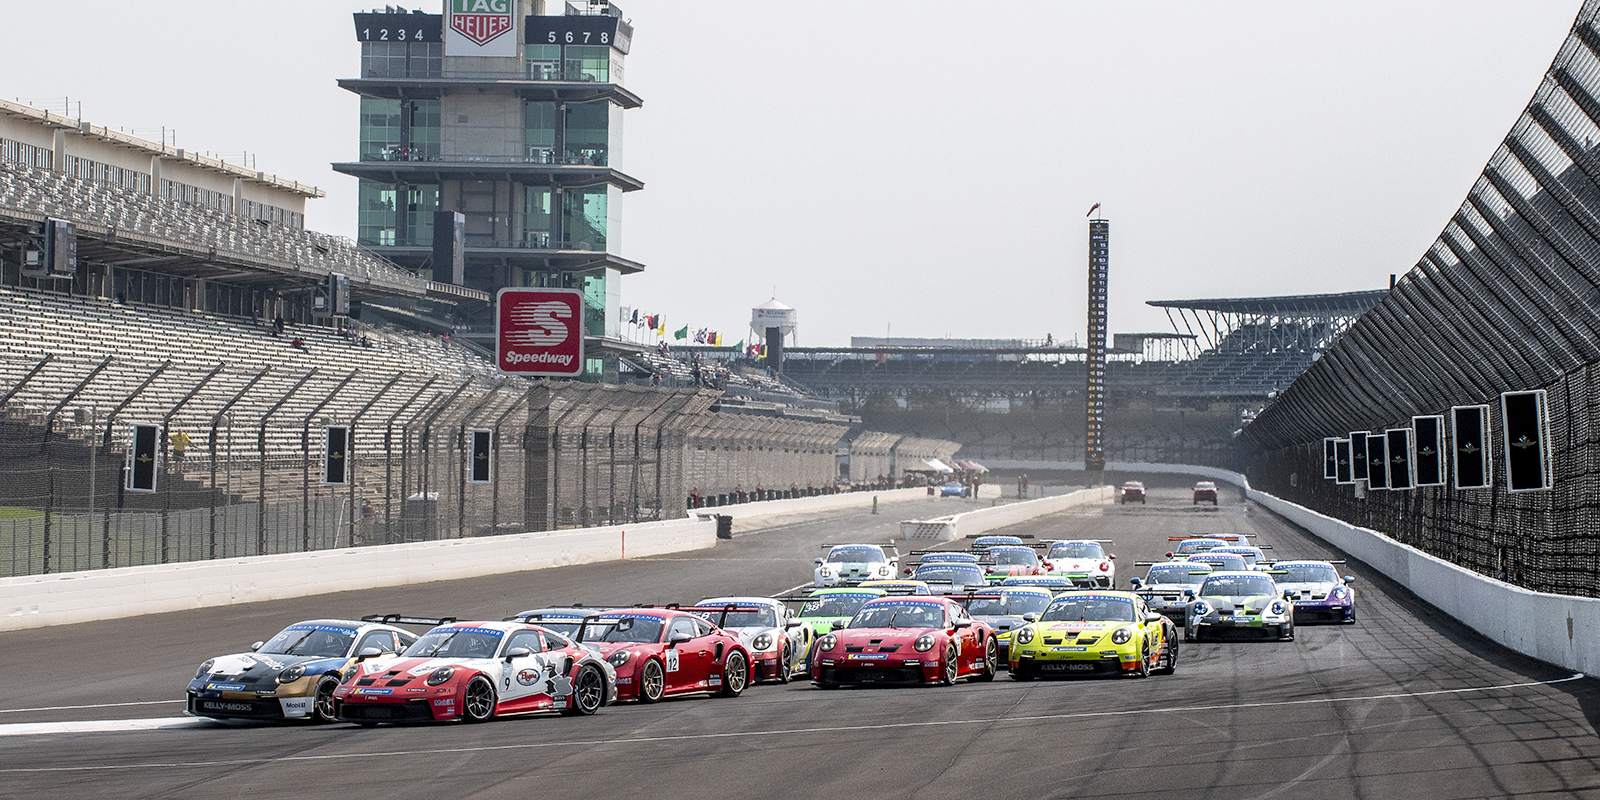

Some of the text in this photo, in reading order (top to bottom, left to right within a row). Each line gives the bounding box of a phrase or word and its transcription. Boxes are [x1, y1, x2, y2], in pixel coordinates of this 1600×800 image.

[462, 0, 507, 13] TAG
[363, 29, 424, 41] 1 2 3 4
[455, 16, 508, 41] HEUER
[548, 32, 609, 44] 5 6 7 8
[505, 351, 574, 366] Speedway
[465, 627, 501, 636] ISLANDS
[668, 658, 678, 671] 12
[504, 677, 511, 691] 9
[203, 701, 252, 711] KELLY-MOSS
